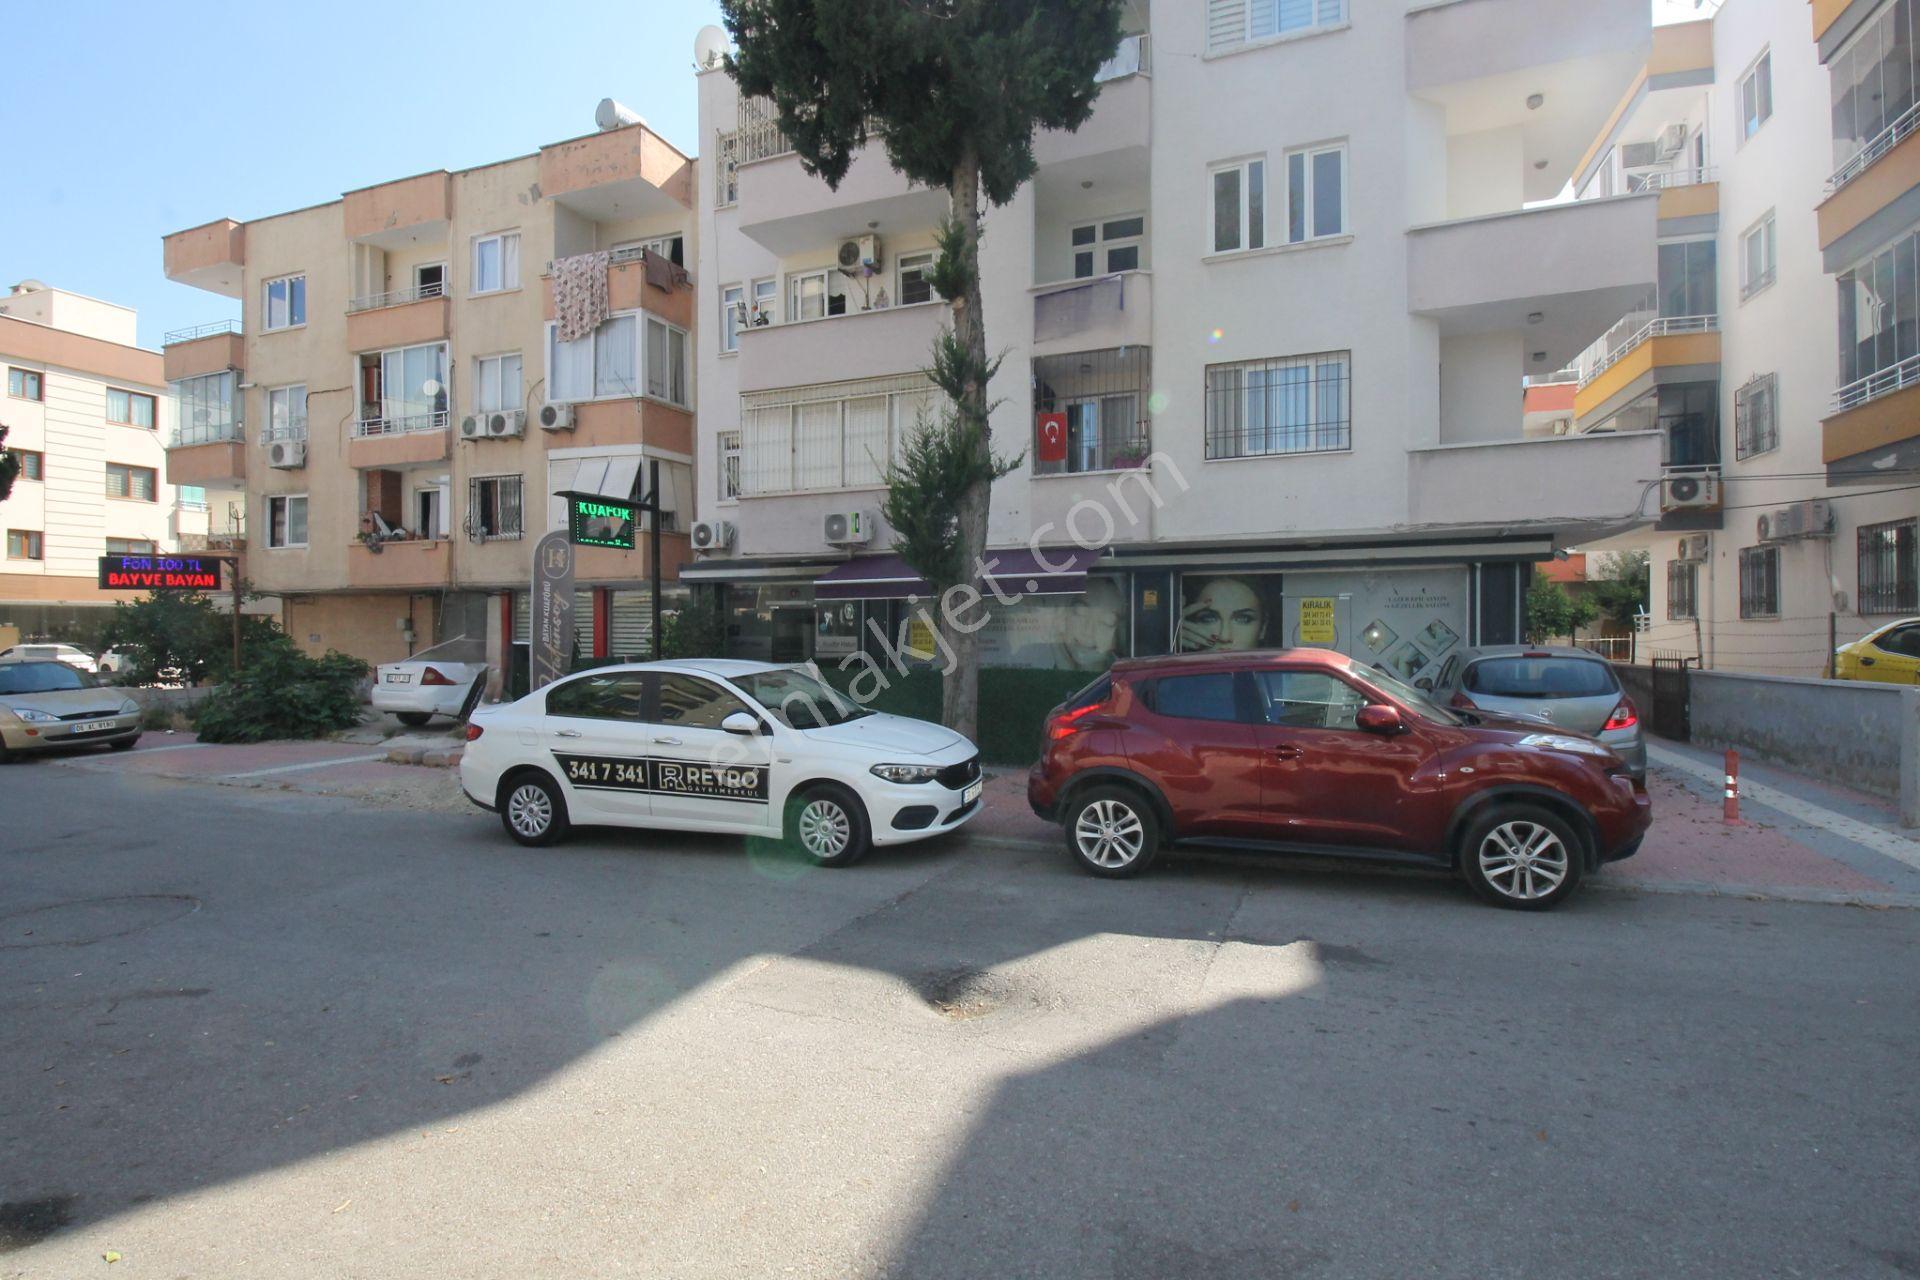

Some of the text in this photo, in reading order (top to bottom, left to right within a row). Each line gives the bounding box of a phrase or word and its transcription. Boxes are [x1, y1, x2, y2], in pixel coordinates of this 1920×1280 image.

[108, 572, 215, 586] BAY VE BAYAN
[569, 761, 645, 783] 341 7 341
[686, 767, 758, 789] RETRO
